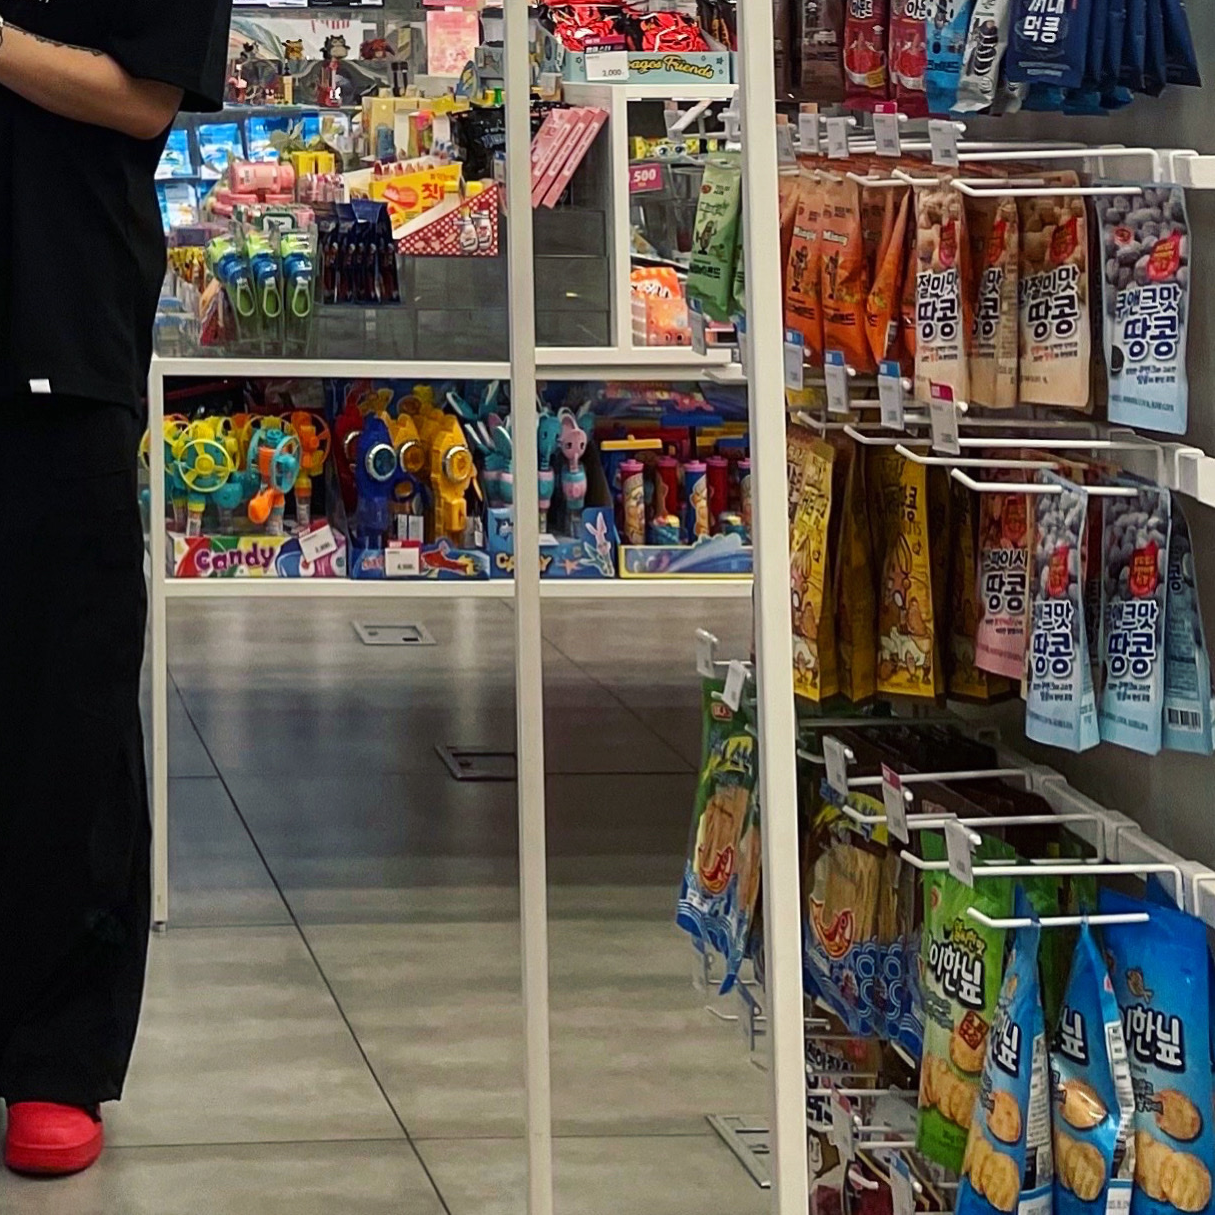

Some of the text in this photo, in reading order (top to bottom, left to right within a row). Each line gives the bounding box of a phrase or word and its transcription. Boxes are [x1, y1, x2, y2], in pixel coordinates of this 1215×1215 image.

[628, 59, 663, 74] ages
[918, 268, 958, 300] 절미맛
[1116, 285, 1182, 318] 쿠앤크맛
[918, 297, 957, 340] 땅콩
[1027, 294, 1078, 339] 땅콩
[1123, 314, 1178, 361] 땅콩
[986, 572, 1026, 611] 땅콩
[1033, 632, 1073, 675] 땅콩
[1108, 632, 1155, 675] 땅콩
[927, 941, 986, 1006] 이한닢
